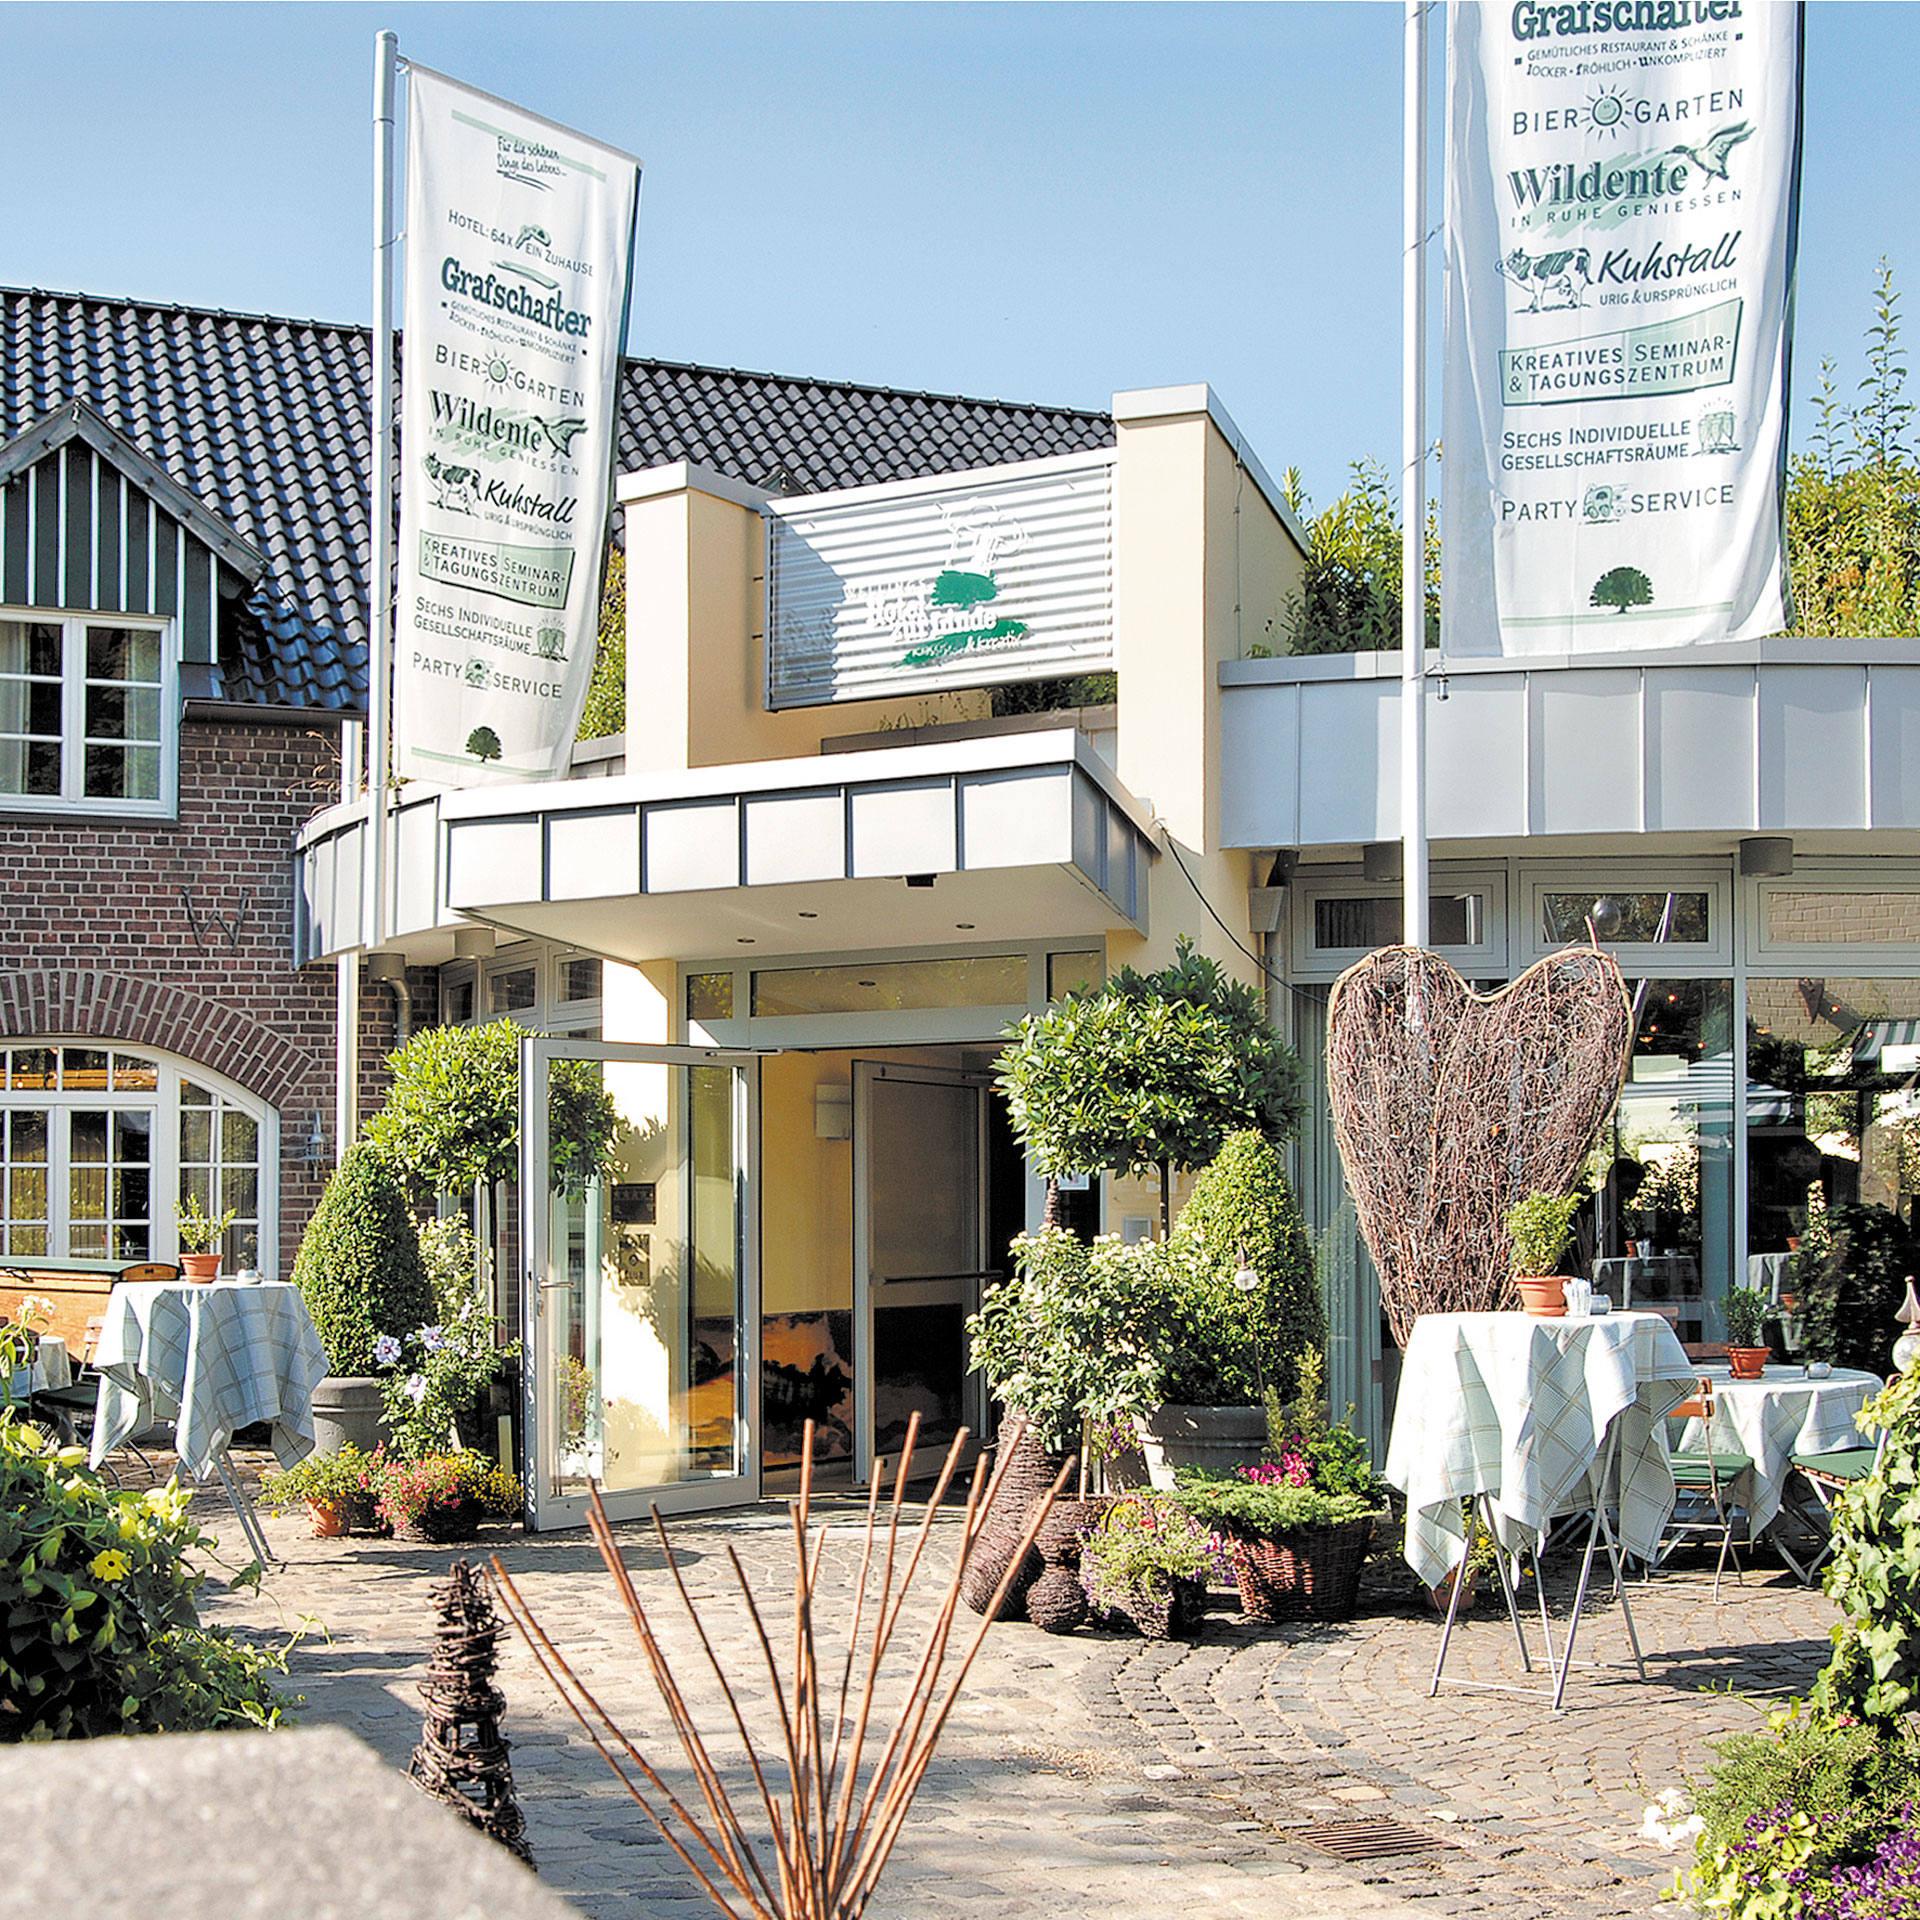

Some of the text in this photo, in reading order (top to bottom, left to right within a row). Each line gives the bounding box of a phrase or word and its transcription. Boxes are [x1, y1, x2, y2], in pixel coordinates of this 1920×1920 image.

[1528, 30, 1729, 62] GEMÜTLICHES RESTAURANT & SCHÄNKE
[1513, 89, 1744, 136] BIER GARTEN
[1507, 161, 1689, 211] Wildente
[1511, 189, 1743, 229] IN RUHE GENIESSEN
[526, 243, 543, 259] EIN
[545, 250, 594, 277] ZUHAUSE
[1597, 230, 1743, 284] Kuhstall
[441, 256, 592, 338] Grafschafter
[1599, 278, 1738, 307] URIG & URSPRÜNGLICH
[1511, 335, 1732, 372] KREATIVES SEMINAR-
[435, 344, 585, 408] BIER GARTEN
[1509, 357, 1725, 393] & TAGUNGSZENTRUM
[428, 388, 544, 453] Wildente
[1503, 419, 1692, 449] SECHS INDIVIDUELLE
[428, 427, 580, 477] IN RUHE GENIESSEN
[1501, 443, 1690, 472] GESELLSCHAFTSRÄUME
[484, 478, 579, 525] Kuhstall
[1502, 484, 1735, 521] PARTY SERVICE
[424, 539, 567, 583] KREATIVES SEMINAR-
[434, 557, 561, 599] TAGUNGSZENTRUM
[414, 614, 532, 656] GESELLSCHAFTSRÄUME
[416, 596, 534, 638] SECHS INDIVIDUELLE
[413, 651, 563, 699] PARTY SERVICE
